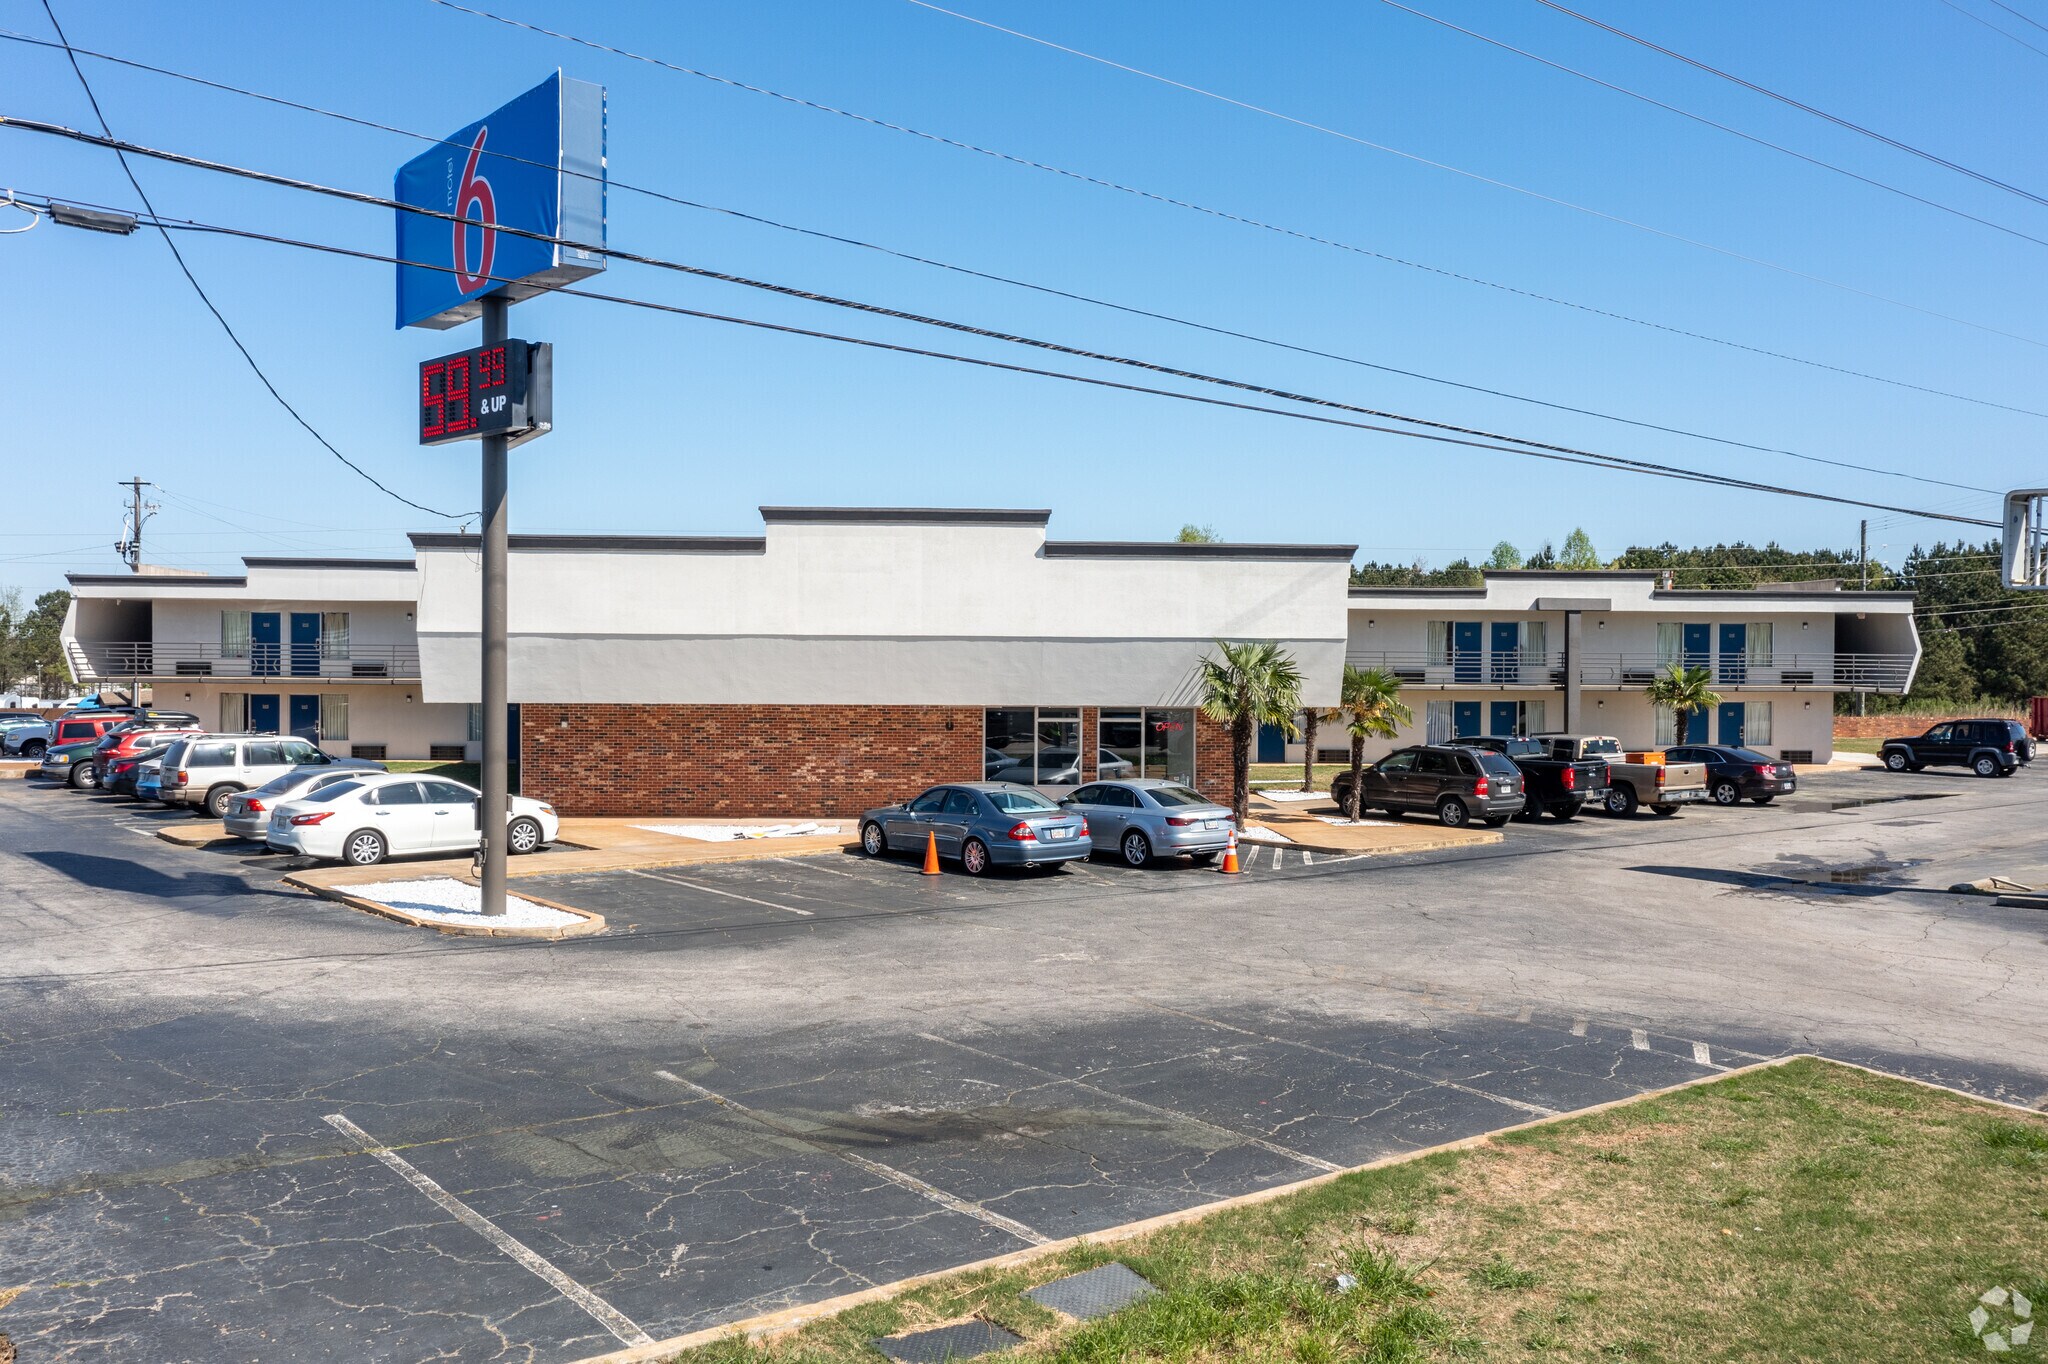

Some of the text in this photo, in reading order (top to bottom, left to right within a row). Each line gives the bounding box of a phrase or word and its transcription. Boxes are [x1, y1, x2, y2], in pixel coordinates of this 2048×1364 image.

[453, 125, 497, 295] 6
[481, 395, 507, 414] & UP
[1156, 721, 1184, 732] OPEN
